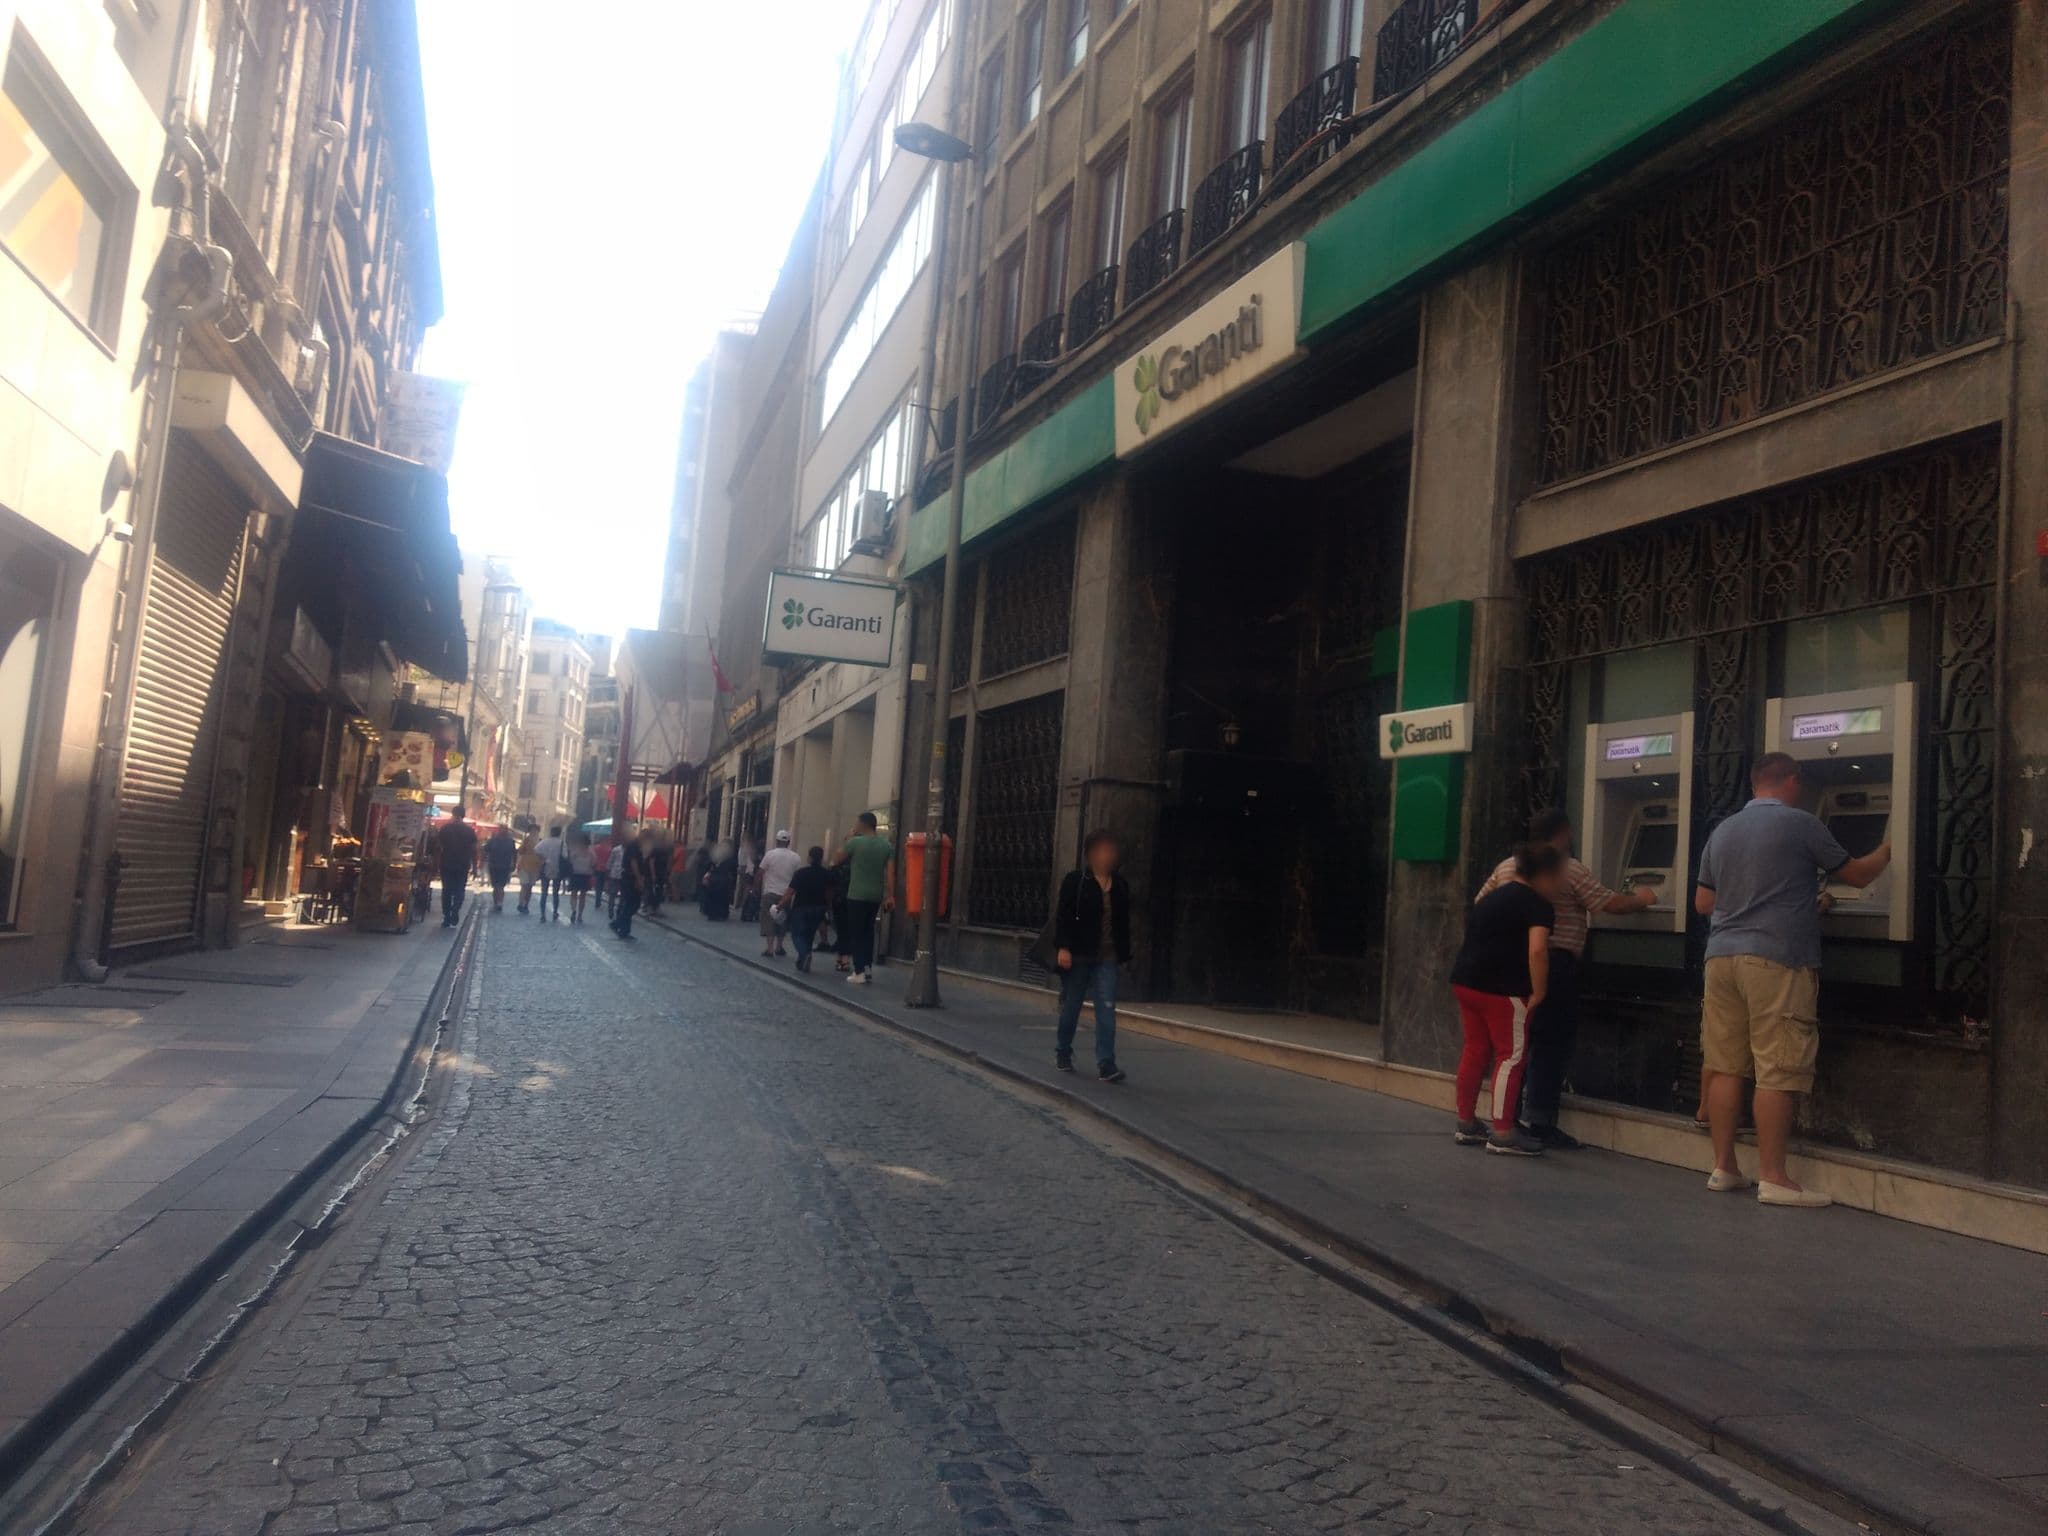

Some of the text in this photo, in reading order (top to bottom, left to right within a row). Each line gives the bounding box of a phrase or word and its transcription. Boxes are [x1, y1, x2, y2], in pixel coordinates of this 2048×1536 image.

[1156, 293, 1262, 402] Garanti
[807, 607, 881, 634] Garanti
[1404, 720, 1452, 744] Garanti
